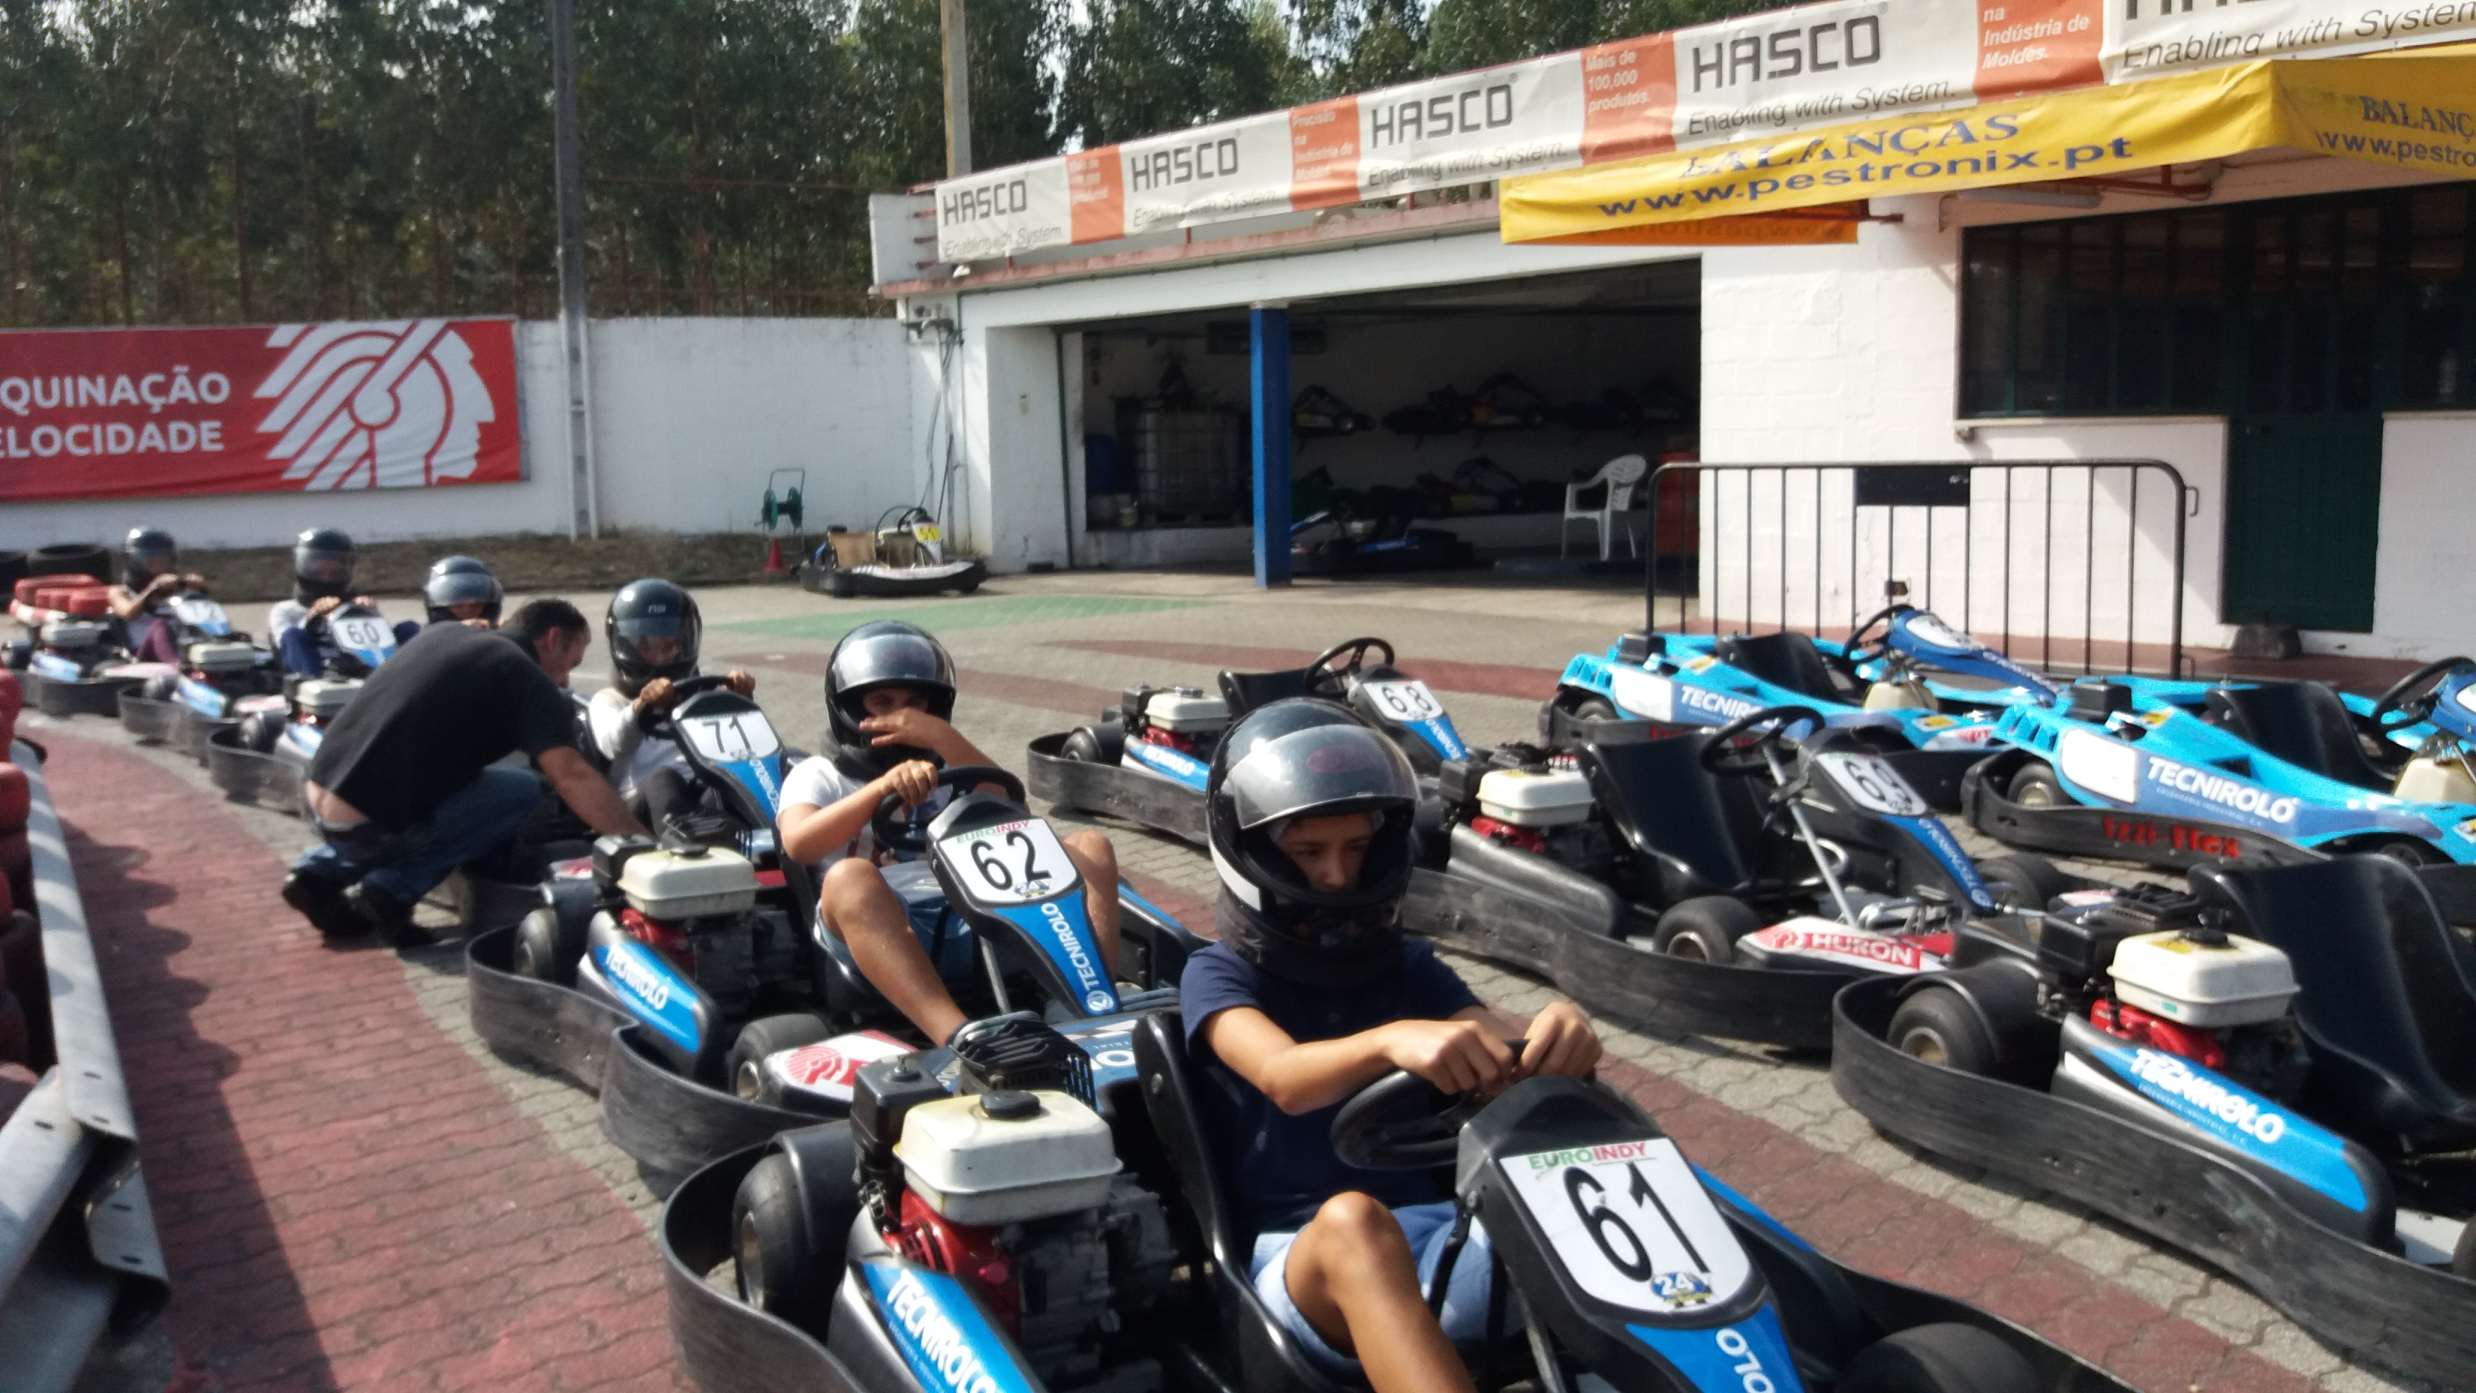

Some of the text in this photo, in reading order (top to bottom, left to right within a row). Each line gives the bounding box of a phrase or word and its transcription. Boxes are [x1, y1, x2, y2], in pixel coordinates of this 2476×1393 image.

[1983, 7, 2006, 22] na
[1983, 13, 2091, 47] Indústria de
[1692, 14, 1881, 93] HASCO
[2122, 30, 2266, 70] Enabling
[2275, 17, 2342, 49] with
[1372, 83, 1513, 148] HASCO
[1688, 79, 1955, 136] Enabling with System.
[1131, 137, 1239, 192] HASCO
[1597, 137, 2135, 218] www.pestronix.pt
[943, 179, 1027, 226] HASCO
[346, 622, 381, 645] 60
[701, 714, 752, 754] 71
[2147, 756, 2294, 824] TECNIROLO
[970, 830, 1053, 891] 62
[1040, 902, 1100, 991] TECNIROLO
[1812, 932, 1914, 966] HURON
[1528, 1141, 1646, 1170] EUROINDY
[1563, 1161, 1711, 1283] 61
